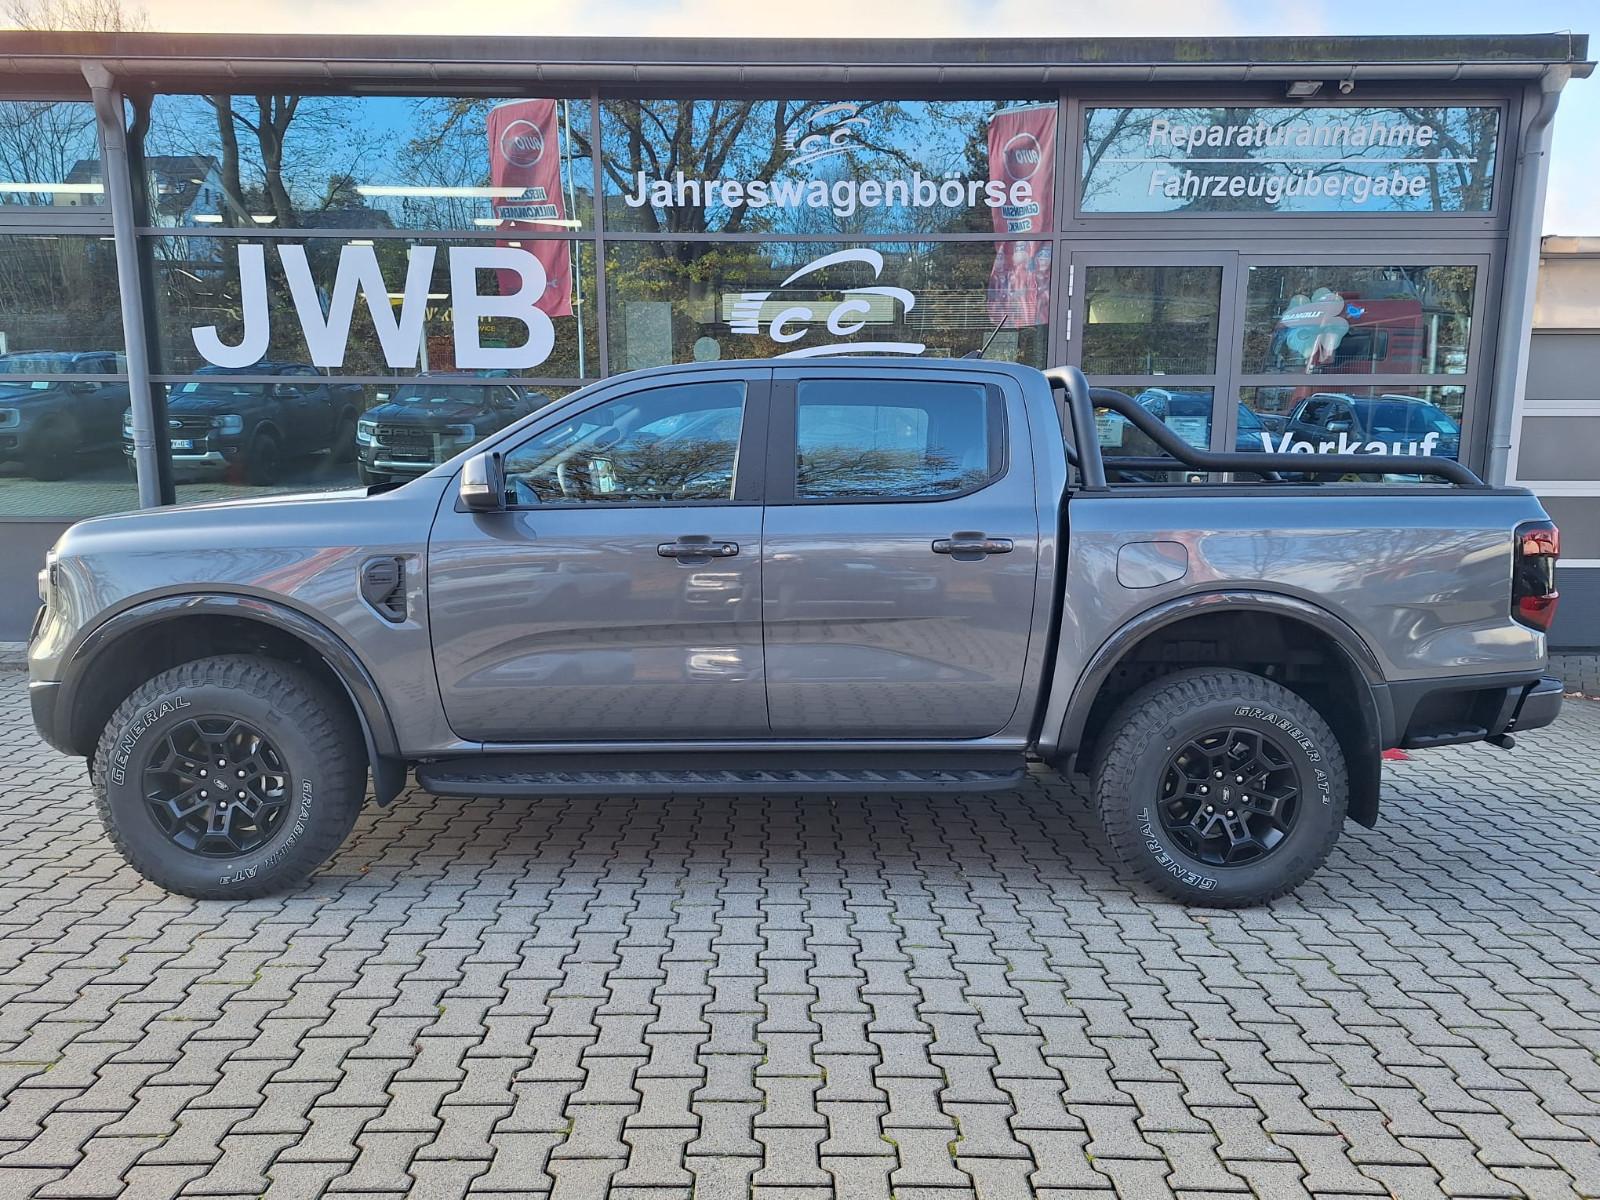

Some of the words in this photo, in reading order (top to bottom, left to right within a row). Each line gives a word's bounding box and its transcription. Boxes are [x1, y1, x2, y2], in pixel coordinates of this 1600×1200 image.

[1148, 119, 1433, 154] Reparaturannahme
[624, 171, 1033, 218] Jahreswagenbörse
[1148, 169, 1427, 204] Fahrzeugübergabe
[191, 243, 556, 369] JWB
[110, 696, 192, 786] GENERAL
[1234, 706, 1321, 762] GRABBER
[264, 779, 313, 867] GRABBER
[1136, 807, 1218, 892] GENERAL
